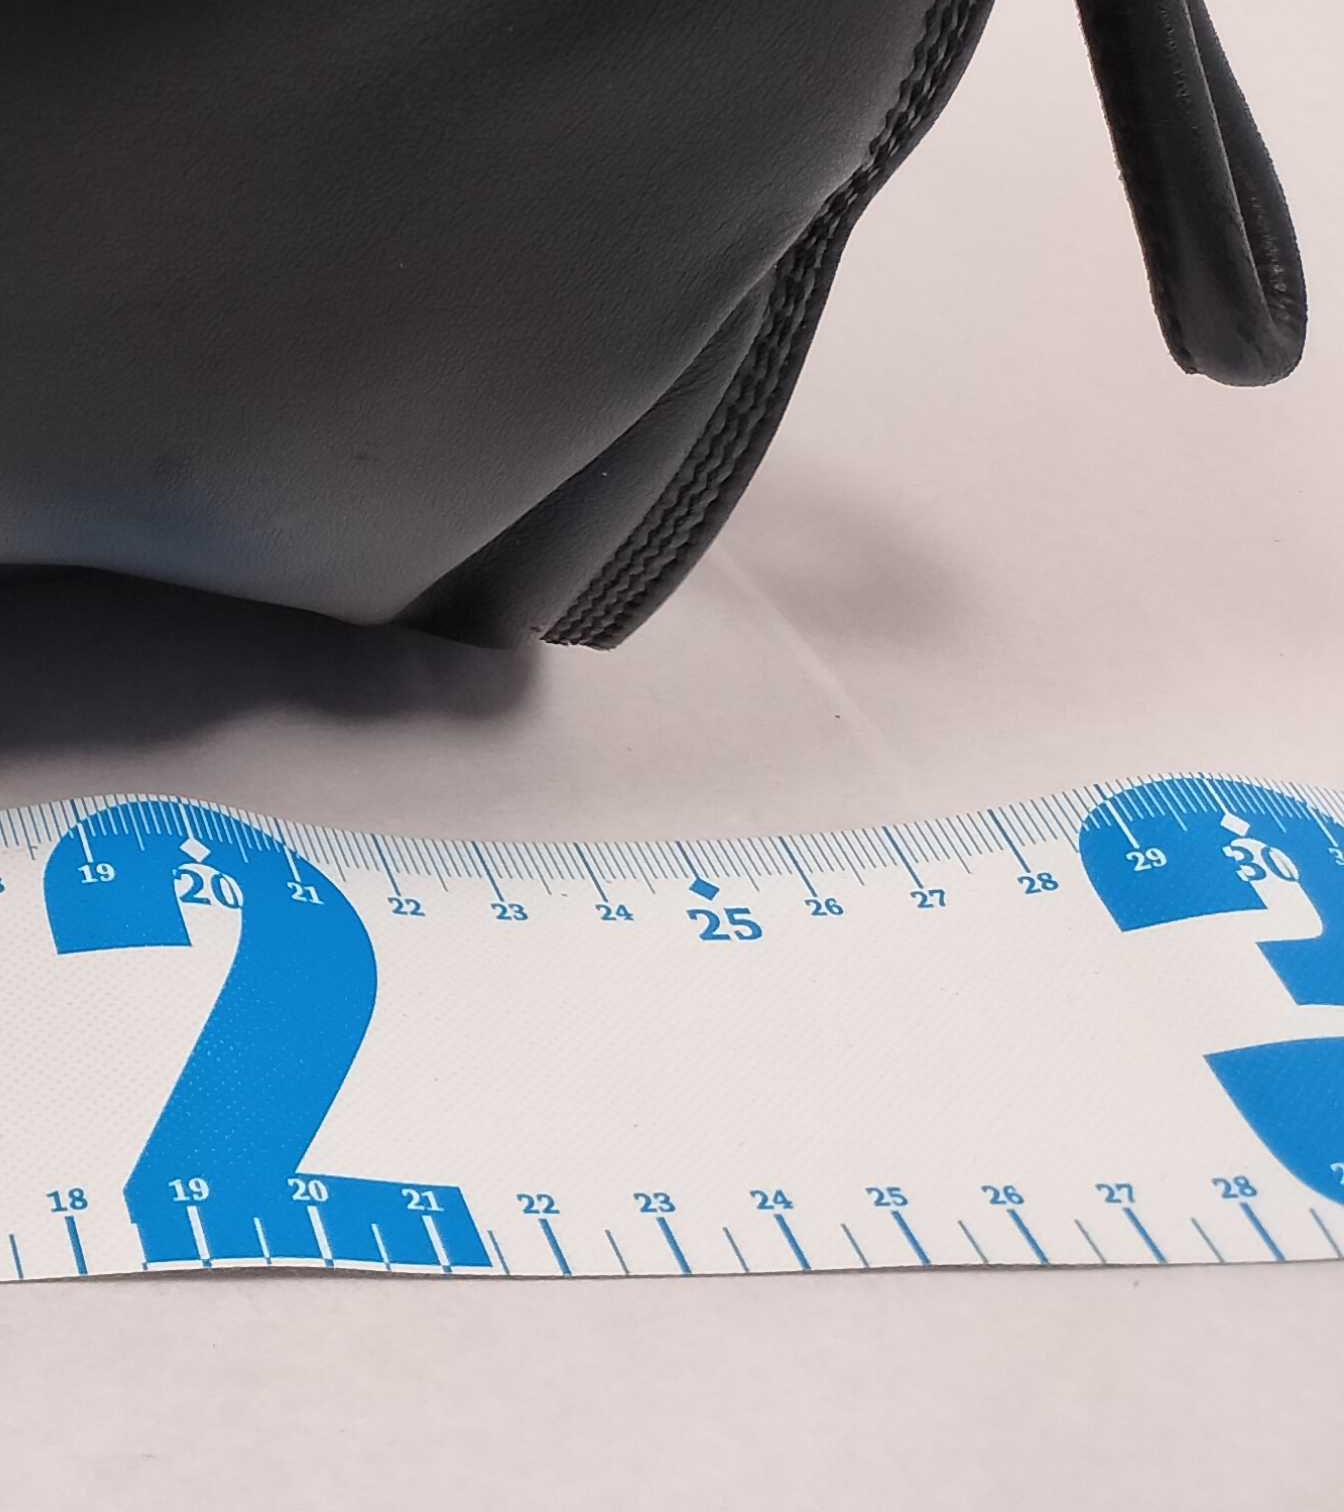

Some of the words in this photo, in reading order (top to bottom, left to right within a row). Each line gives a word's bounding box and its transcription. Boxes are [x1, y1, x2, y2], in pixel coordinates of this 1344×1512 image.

[77, 862, 116, 884] 19
[172, 864, 243, 909] 20
[286, 881, 324, 905] 21
[388, 897, 425, 917] 22
[491, 902, 528, 922] 23
[595, 903, 634, 922] 24
[688, 908, 763, 941] 25
[805, 897, 845, 917] 26
[910, 889, 946, 909] 27
[1018, 872, 1059, 895] 28
[1125, 847, 1168, 871] 29
[1224, 837, 1300, 883] 30
[43, 799, 493, 1268] 2
[46, 1189, 90, 1212] 18
[168, 1177, 210, 1201] 19
[287, 1177, 330, 1202] 20
[401, 1189, 444, 1212] 21
[516, 1194, 560, 1215] 22
[633, 1192, 676, 1213] 23
[750, 1190, 793, 1210] 24
[866, 1187, 908, 1208] 25
[982, 1186, 1024, 1206] 26
[1096, 1184, 1137, 1204] 27
[1212, 1176, 1257, 1199] 28
